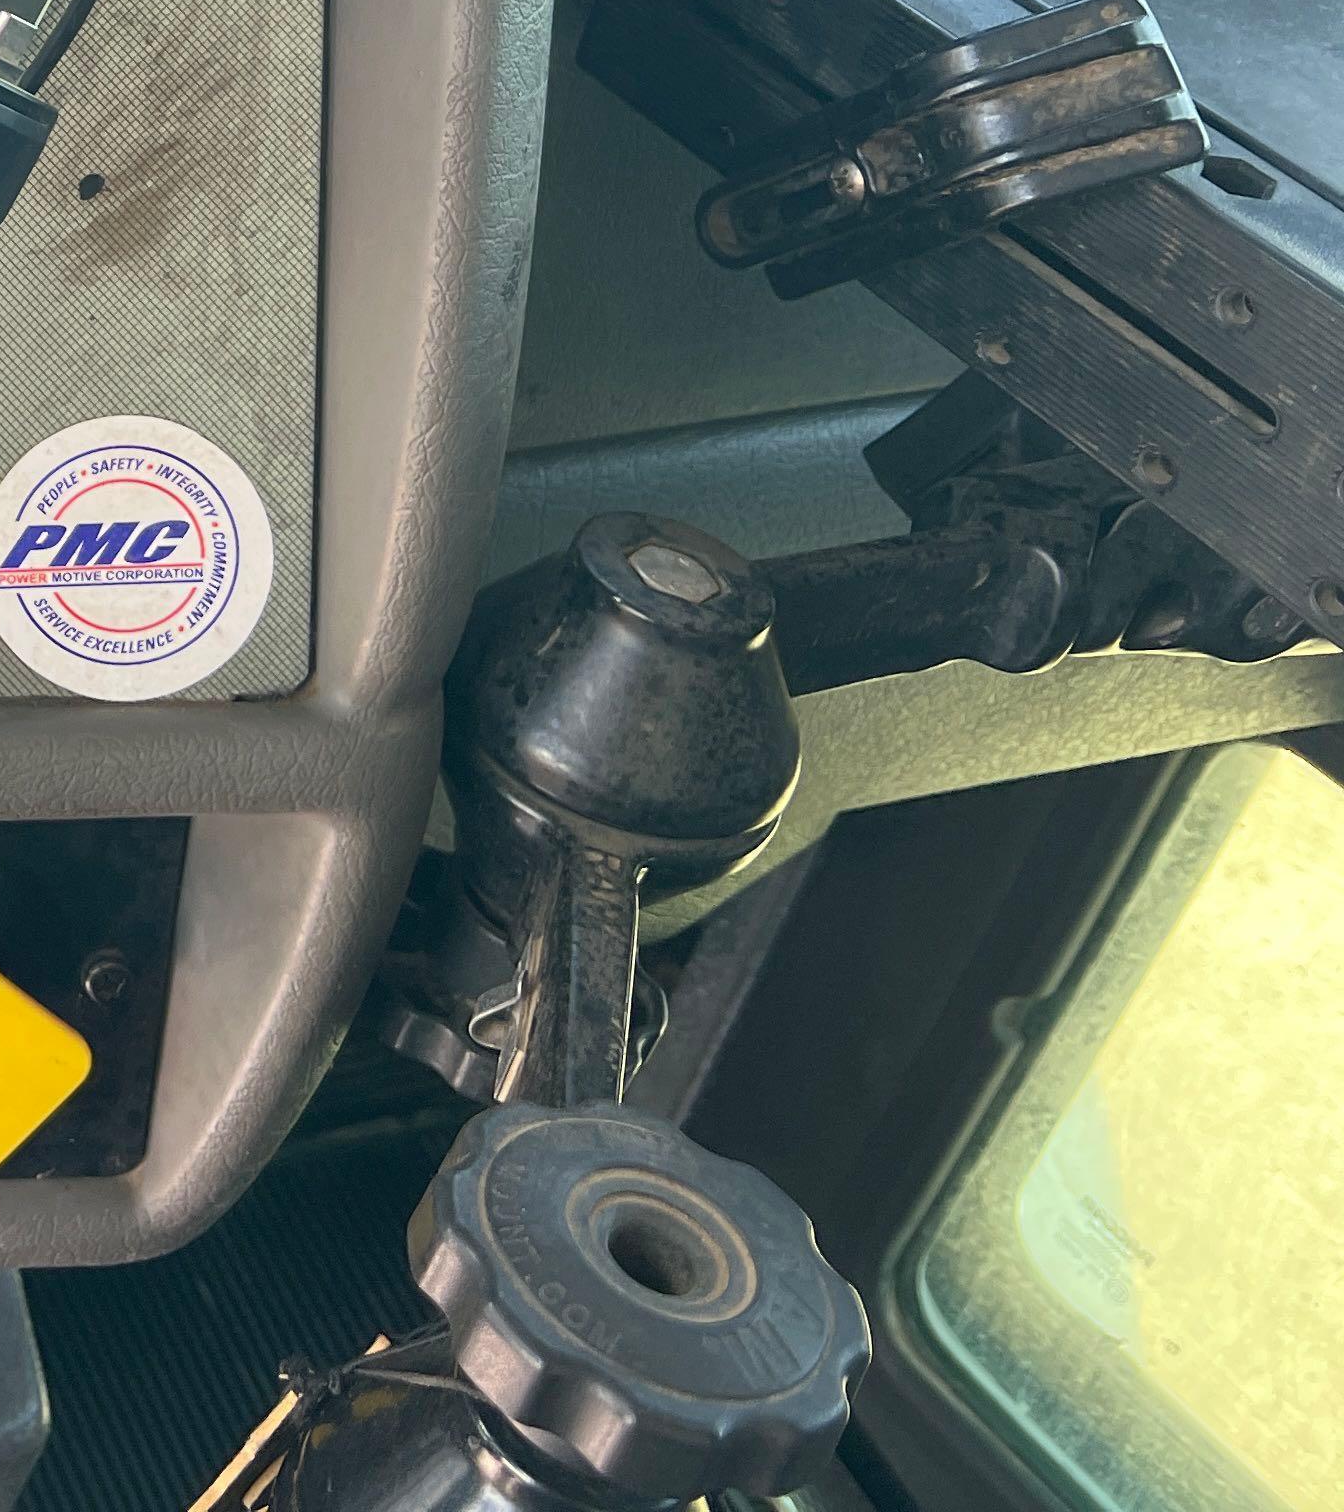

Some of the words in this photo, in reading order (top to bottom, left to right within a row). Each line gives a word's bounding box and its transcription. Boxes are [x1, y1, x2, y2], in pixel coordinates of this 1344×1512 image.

[90, 457, 146, 476] SAFETY
[155, 463, 219, 518] INTEGRITY
[36, 470, 81, 516] PEOPLE
[0, 519, 191, 570] PMC
[51, 569, 103, 584] MOTIVE
[105, 567, 205, 582] CORPORATION
[185, 531, 228, 630] COMMITMENT
[33, 597, 85, 644] SERVICE
[83, 629, 175, 655] EXCELLENCE
